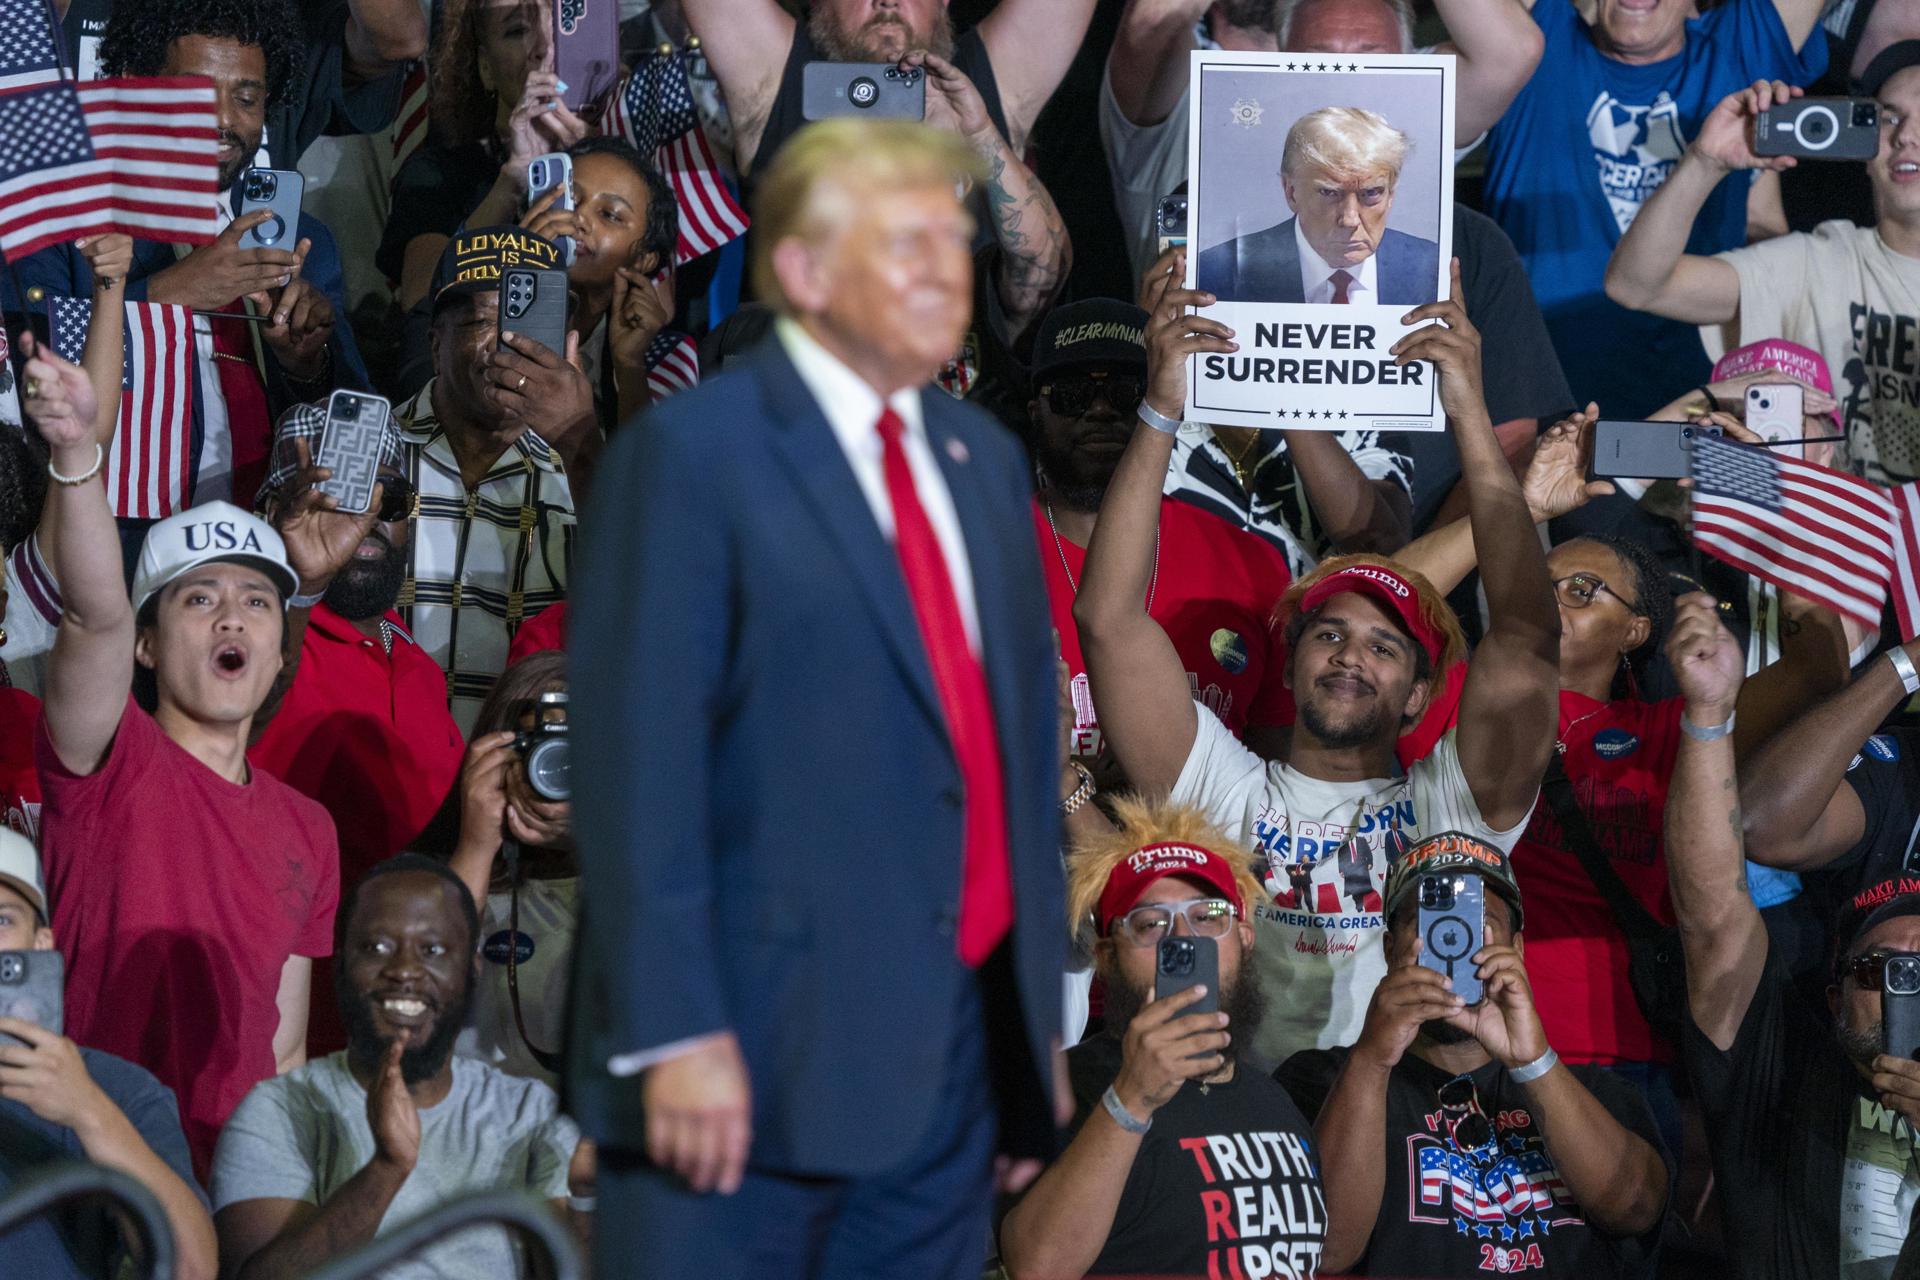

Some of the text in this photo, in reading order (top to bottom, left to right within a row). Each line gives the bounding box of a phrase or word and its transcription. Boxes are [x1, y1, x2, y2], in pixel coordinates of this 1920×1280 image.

[456, 233, 558, 263] LOYALTY
[502, 250, 520, 265] IS
[1255, 322, 1376, 349] NEVER
[1850, 301, 1920, 375] FRE
[1204, 355, 1424, 385] SURRENDER
[1761, 346, 1818, 379] AMERICA
[181, 520, 263, 553] USA
[1128, 846, 1208, 870] Trump
[1154, 860, 1189, 872] 2024
[1405, 838, 1502, 870] TRUMP
[1853, 879, 1896, 909] MAKE
[1265, 908, 1336, 930] AMERICA
[1425, 1109, 1443, 1132] I'
[1419, 1145, 1577, 1223] FELON
[1206, 1241, 1324, 1280] UPSET
